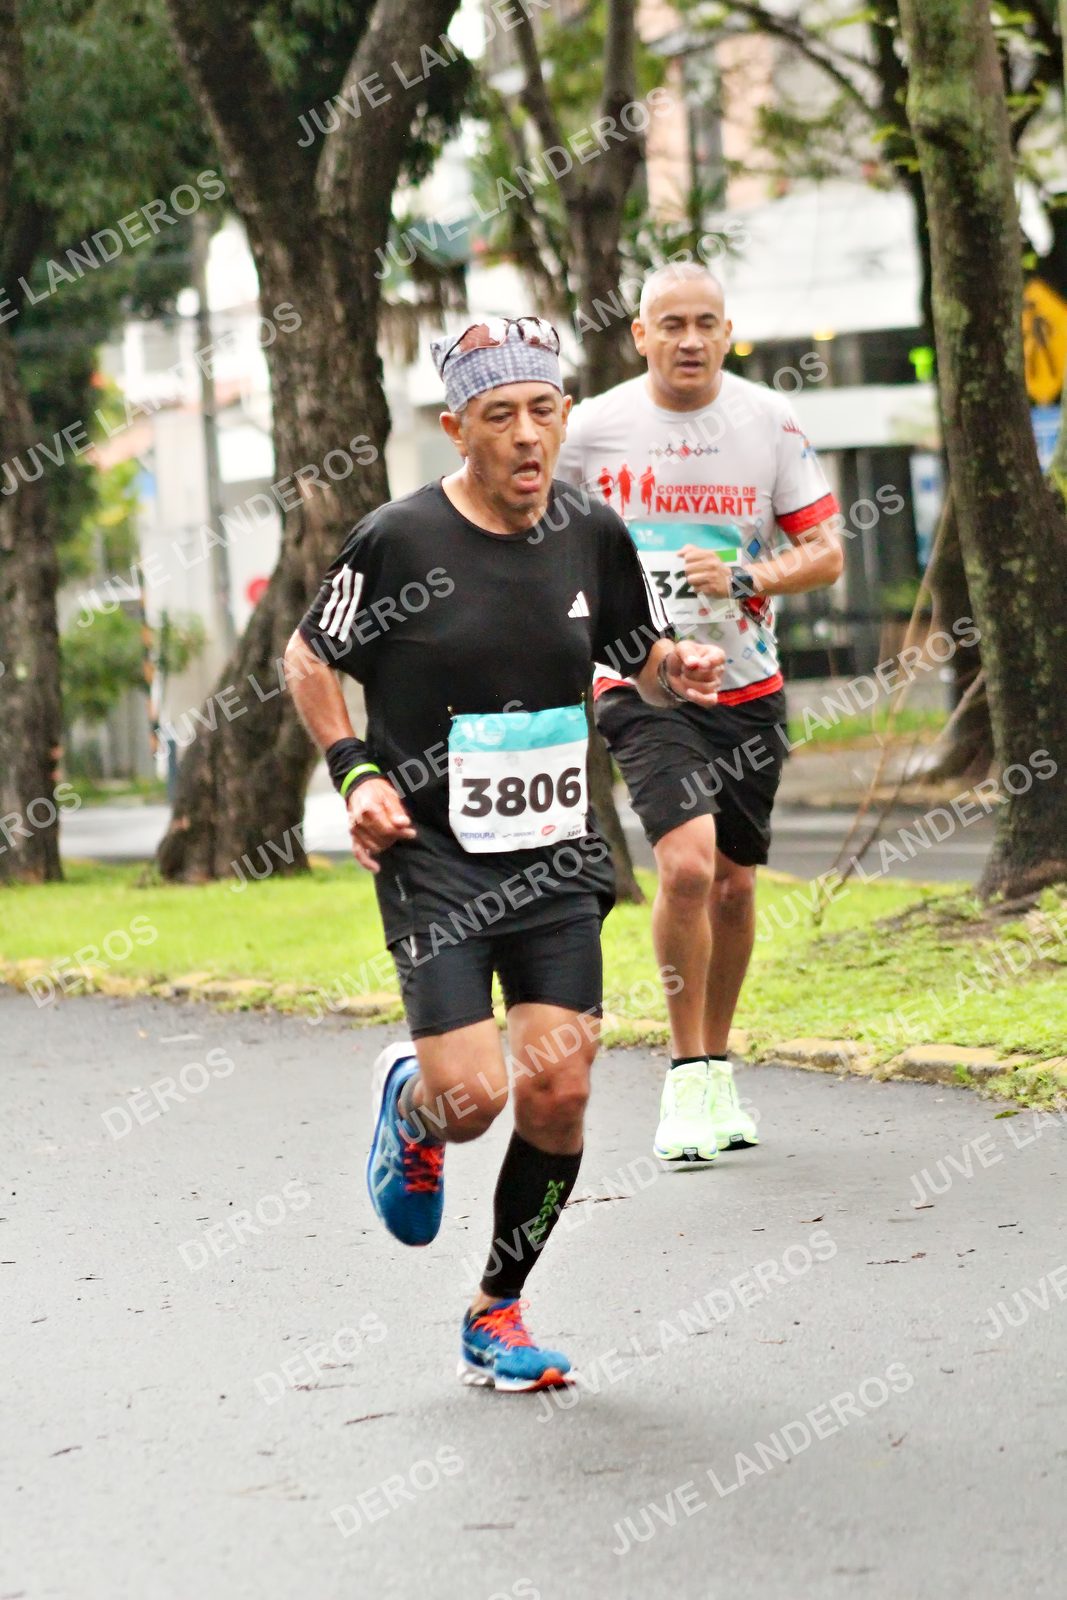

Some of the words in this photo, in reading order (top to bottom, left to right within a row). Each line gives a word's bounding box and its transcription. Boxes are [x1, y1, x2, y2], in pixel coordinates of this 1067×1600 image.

[657, 485, 738, 495] CORREDORES
[742, 487, 756, 496] DE
[656, 495, 756, 516] NAYARIT
[650, 570, 698, 599] 32
[460, 767, 581, 818] 3806
